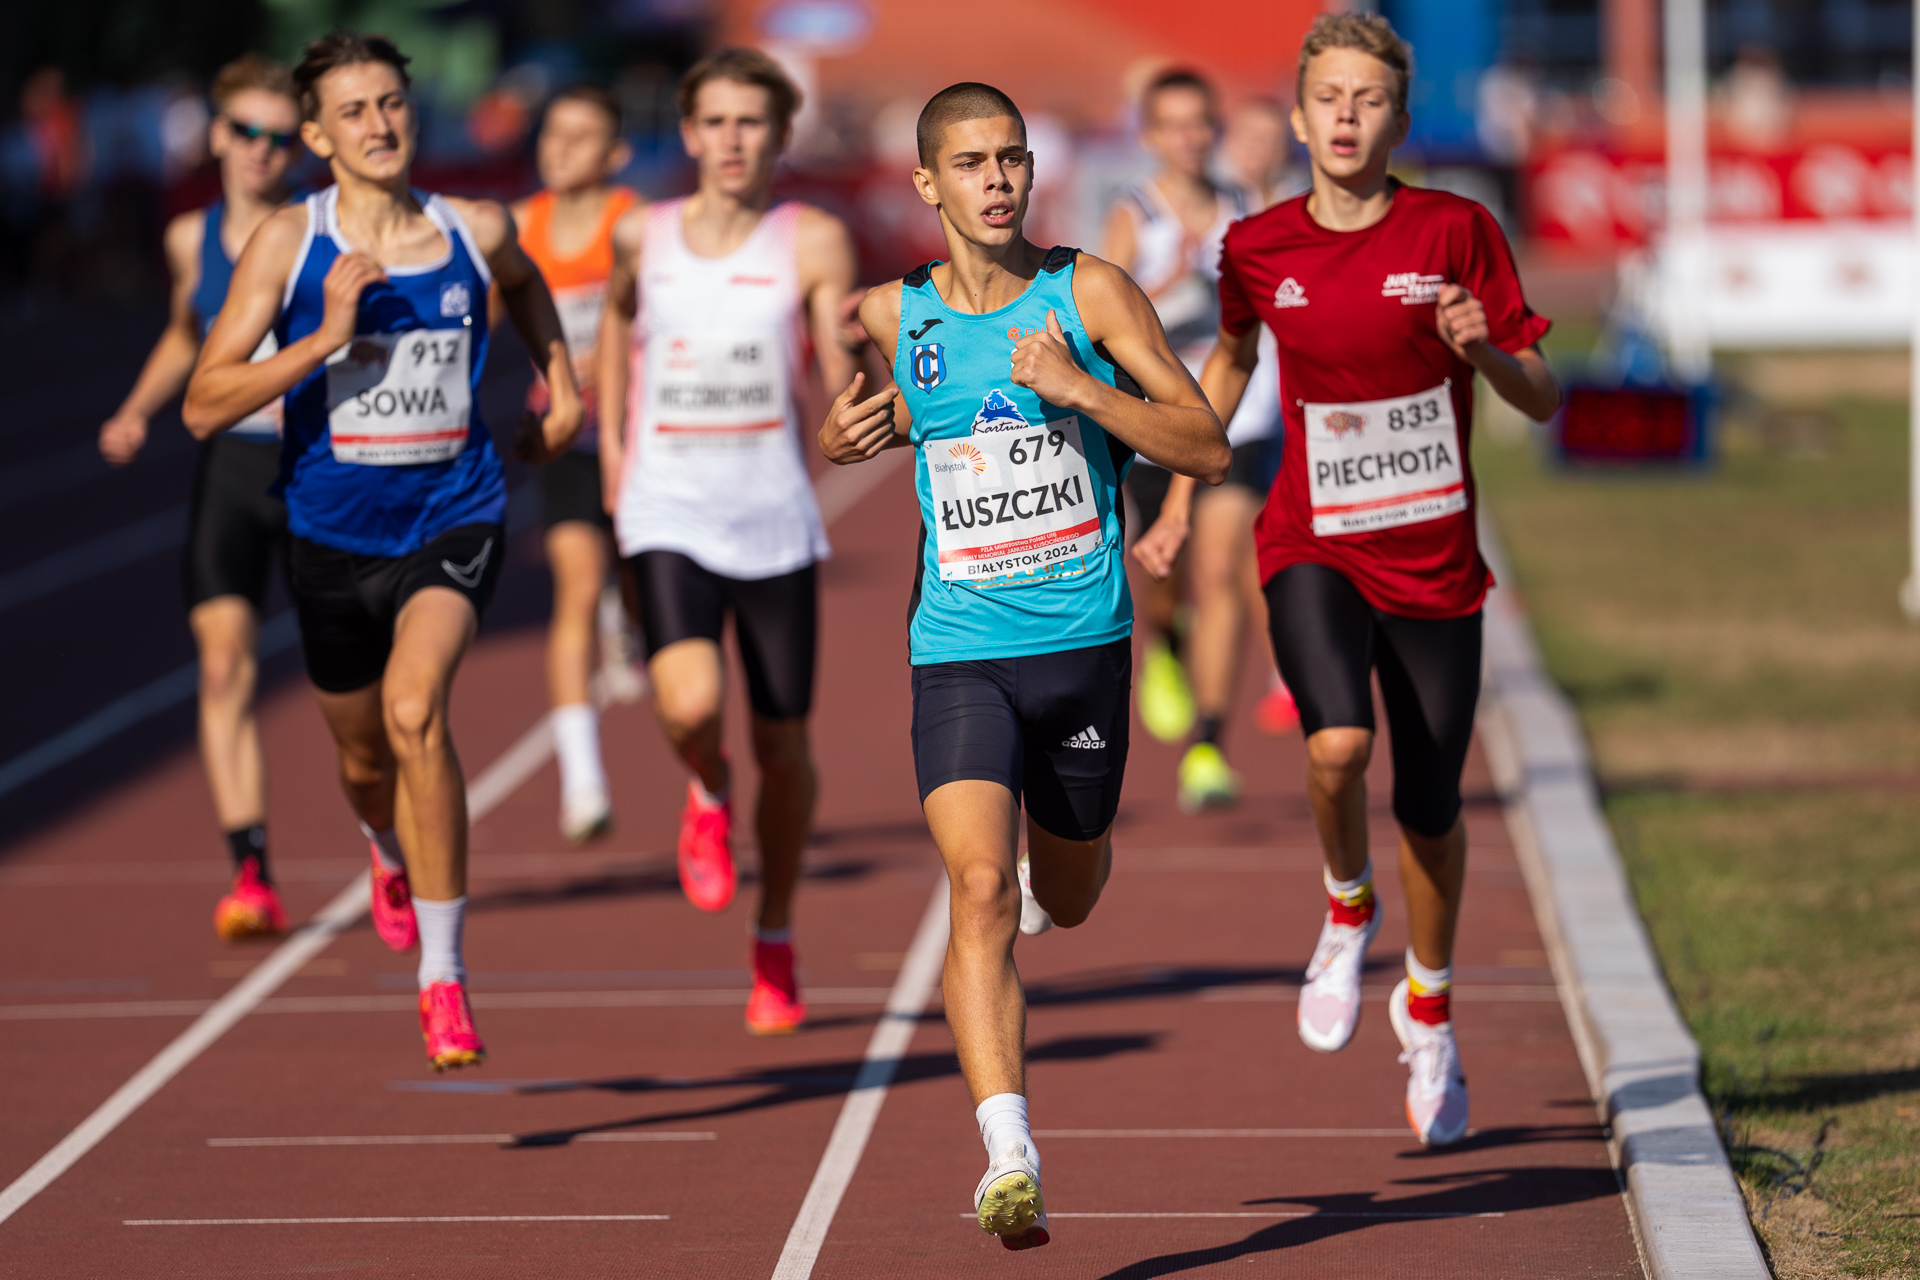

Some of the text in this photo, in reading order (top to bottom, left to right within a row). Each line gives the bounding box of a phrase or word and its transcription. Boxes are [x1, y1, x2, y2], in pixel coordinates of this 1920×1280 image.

[410, 340, 459, 365] 912
[355, 387, 449, 418] SOWA
[1388, 399, 1440, 432] 833
[1009, 430, 1065, 465] 679
[934, 461, 968, 474] Białystok
[1316, 441, 1453, 487] PIECHOTA
[942, 475, 1084, 531] ŁUSZCZKI
[994, 540, 1029, 551] Mistrzostwa
[1029, 535, 1046, 544] Polski
[1047, 531, 1057, 539] U16
[1007, 545, 1032, 554] JANUSZA
[968, 553, 1042, 575] BIAŁYSTOK
[1044, 543, 1078, 561] 2024
[1061, 740, 1106, 749] adidas
